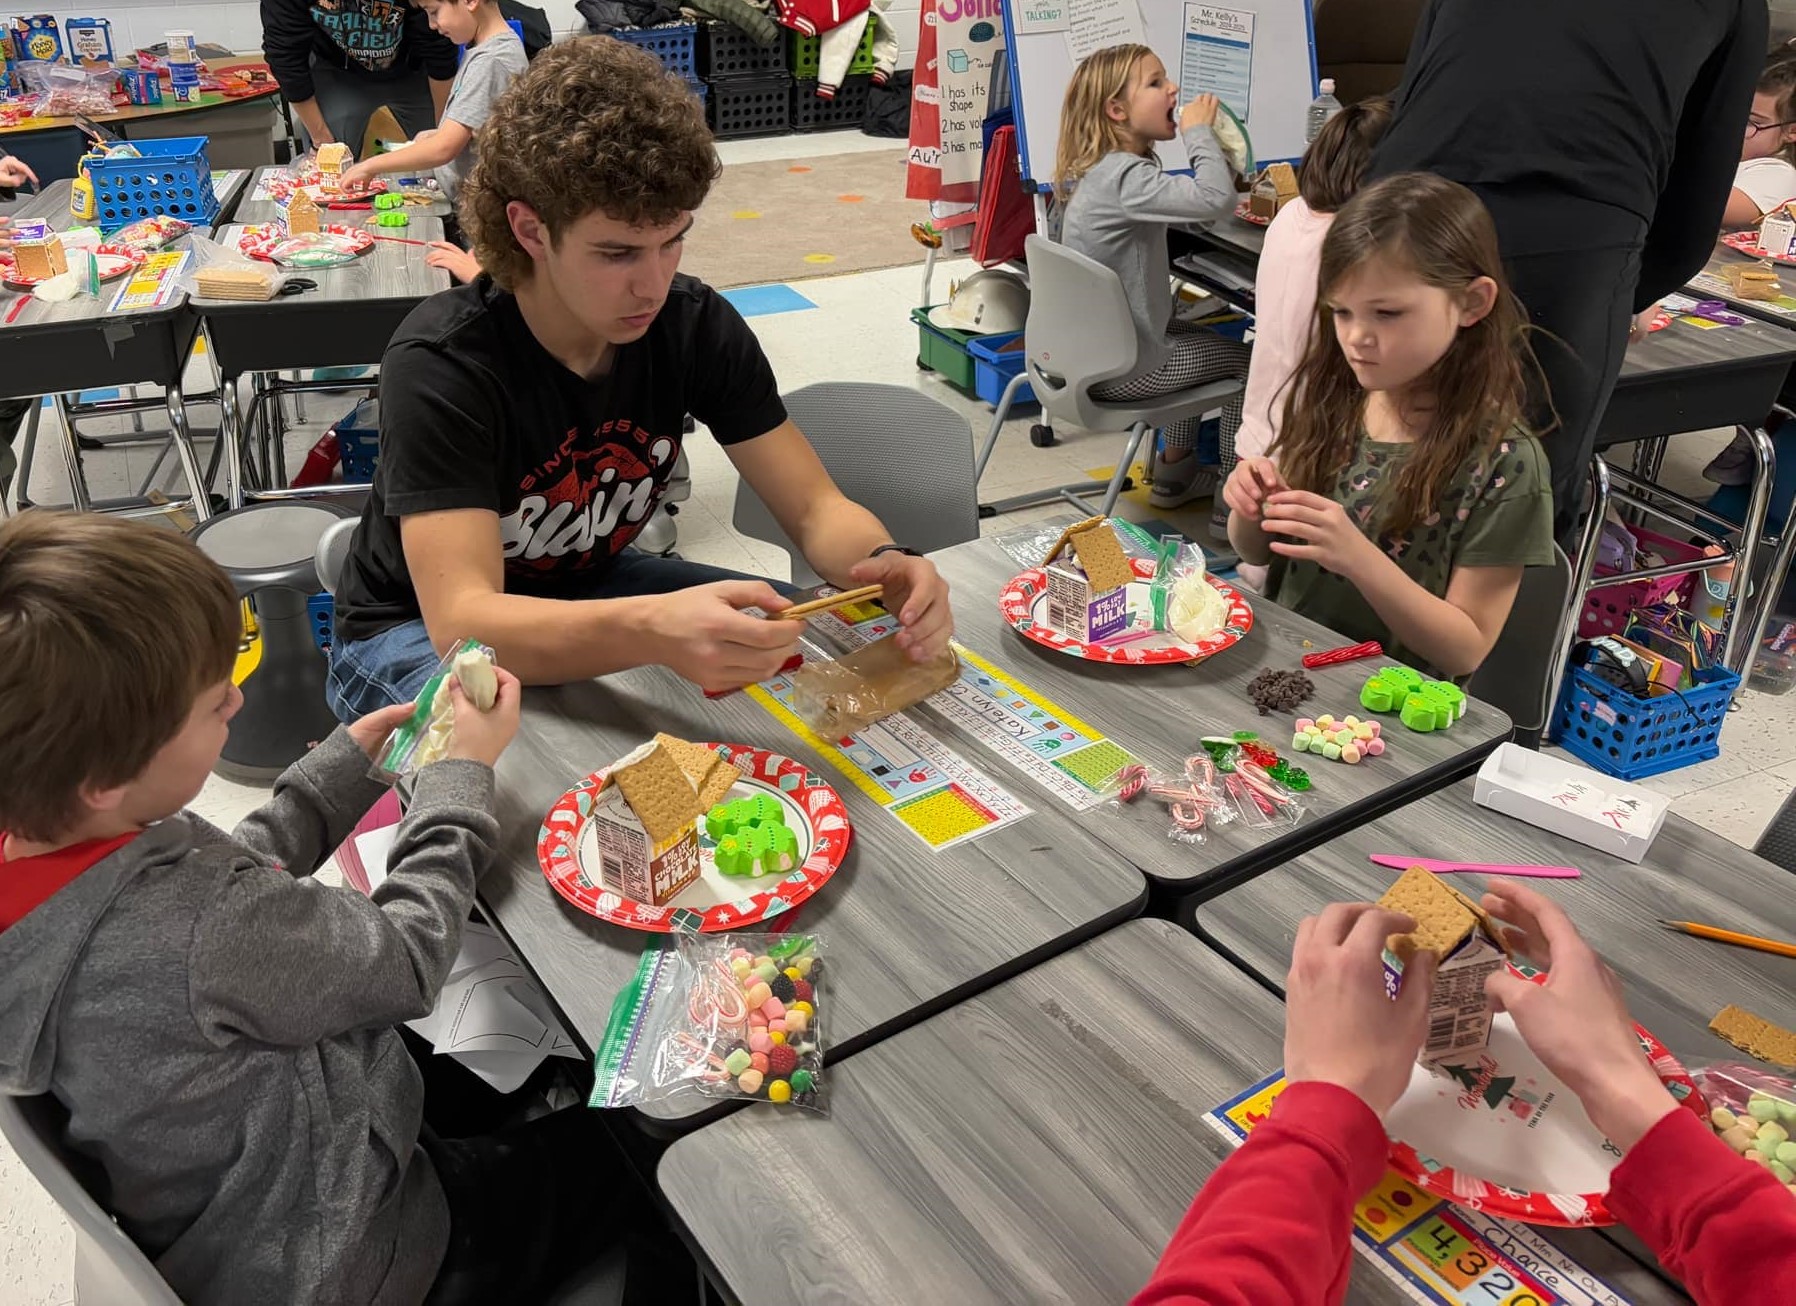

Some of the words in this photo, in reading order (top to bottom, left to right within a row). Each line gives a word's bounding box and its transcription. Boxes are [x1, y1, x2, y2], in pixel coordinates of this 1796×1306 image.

[1025, 9, 1062, 21] TALKING?
[949, 85, 966, 99] has
[972, 81, 986, 97] its
[949, 99, 974, 113] shape
[942, 119, 948, 133] 2
[950, 119, 966, 131] has
[942, 141, 949, 154] 3
[951, 141, 966, 153] has
[520, 427, 578, 491] SINCE
[1092, 603, 1125, 629] MILK
[1095, 600, 1110, 615] 1%
[971, 694, 1031, 740] Katelyn
[655, 842, 698, 881] CHOCOLATE
[661, 849, 678, 868] 1%
[655, 850, 699, 897] MILK
[1484, 1226, 1559, 1289] Chance
[1530, 1237, 1552, 1258] Mm
[1558, 1258, 1575, 1274] Nn
[1581, 1276, 1599, 1293] Oo
